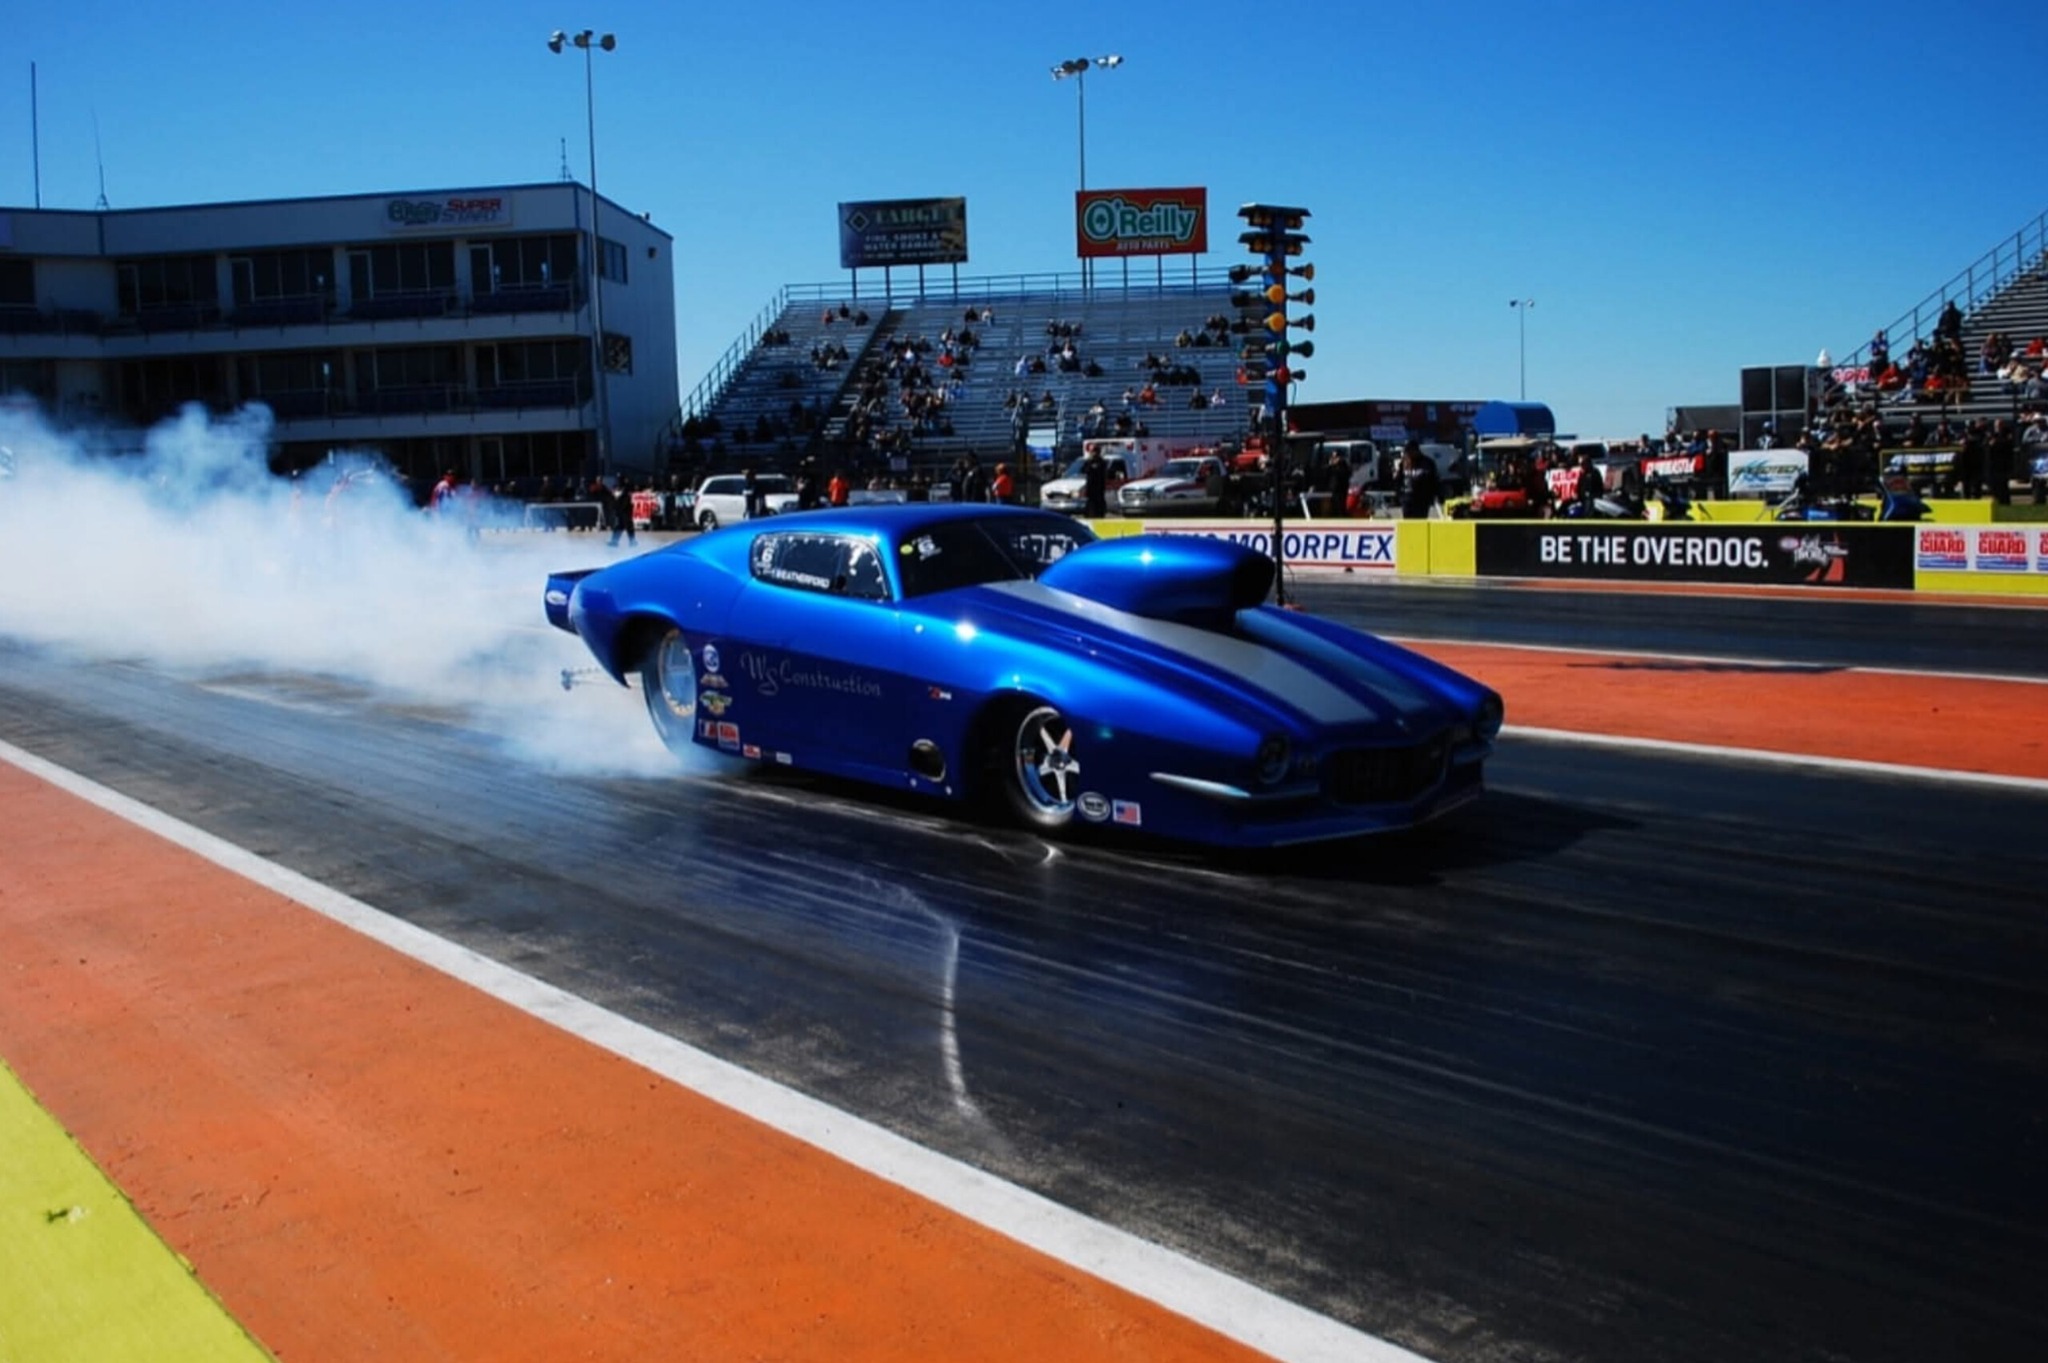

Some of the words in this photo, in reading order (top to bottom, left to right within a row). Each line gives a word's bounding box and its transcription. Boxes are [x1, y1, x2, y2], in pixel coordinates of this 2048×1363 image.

[1084, 197, 1197, 241] O'Reilly
[1540, 535, 1572, 563] BE
[1577, 535, 1627, 564] THE
[1633, 536, 1769, 568] OVERDOG.
[1920, 539, 1965, 553] GUARD
[1978, 540, 2026, 555] GUARD
